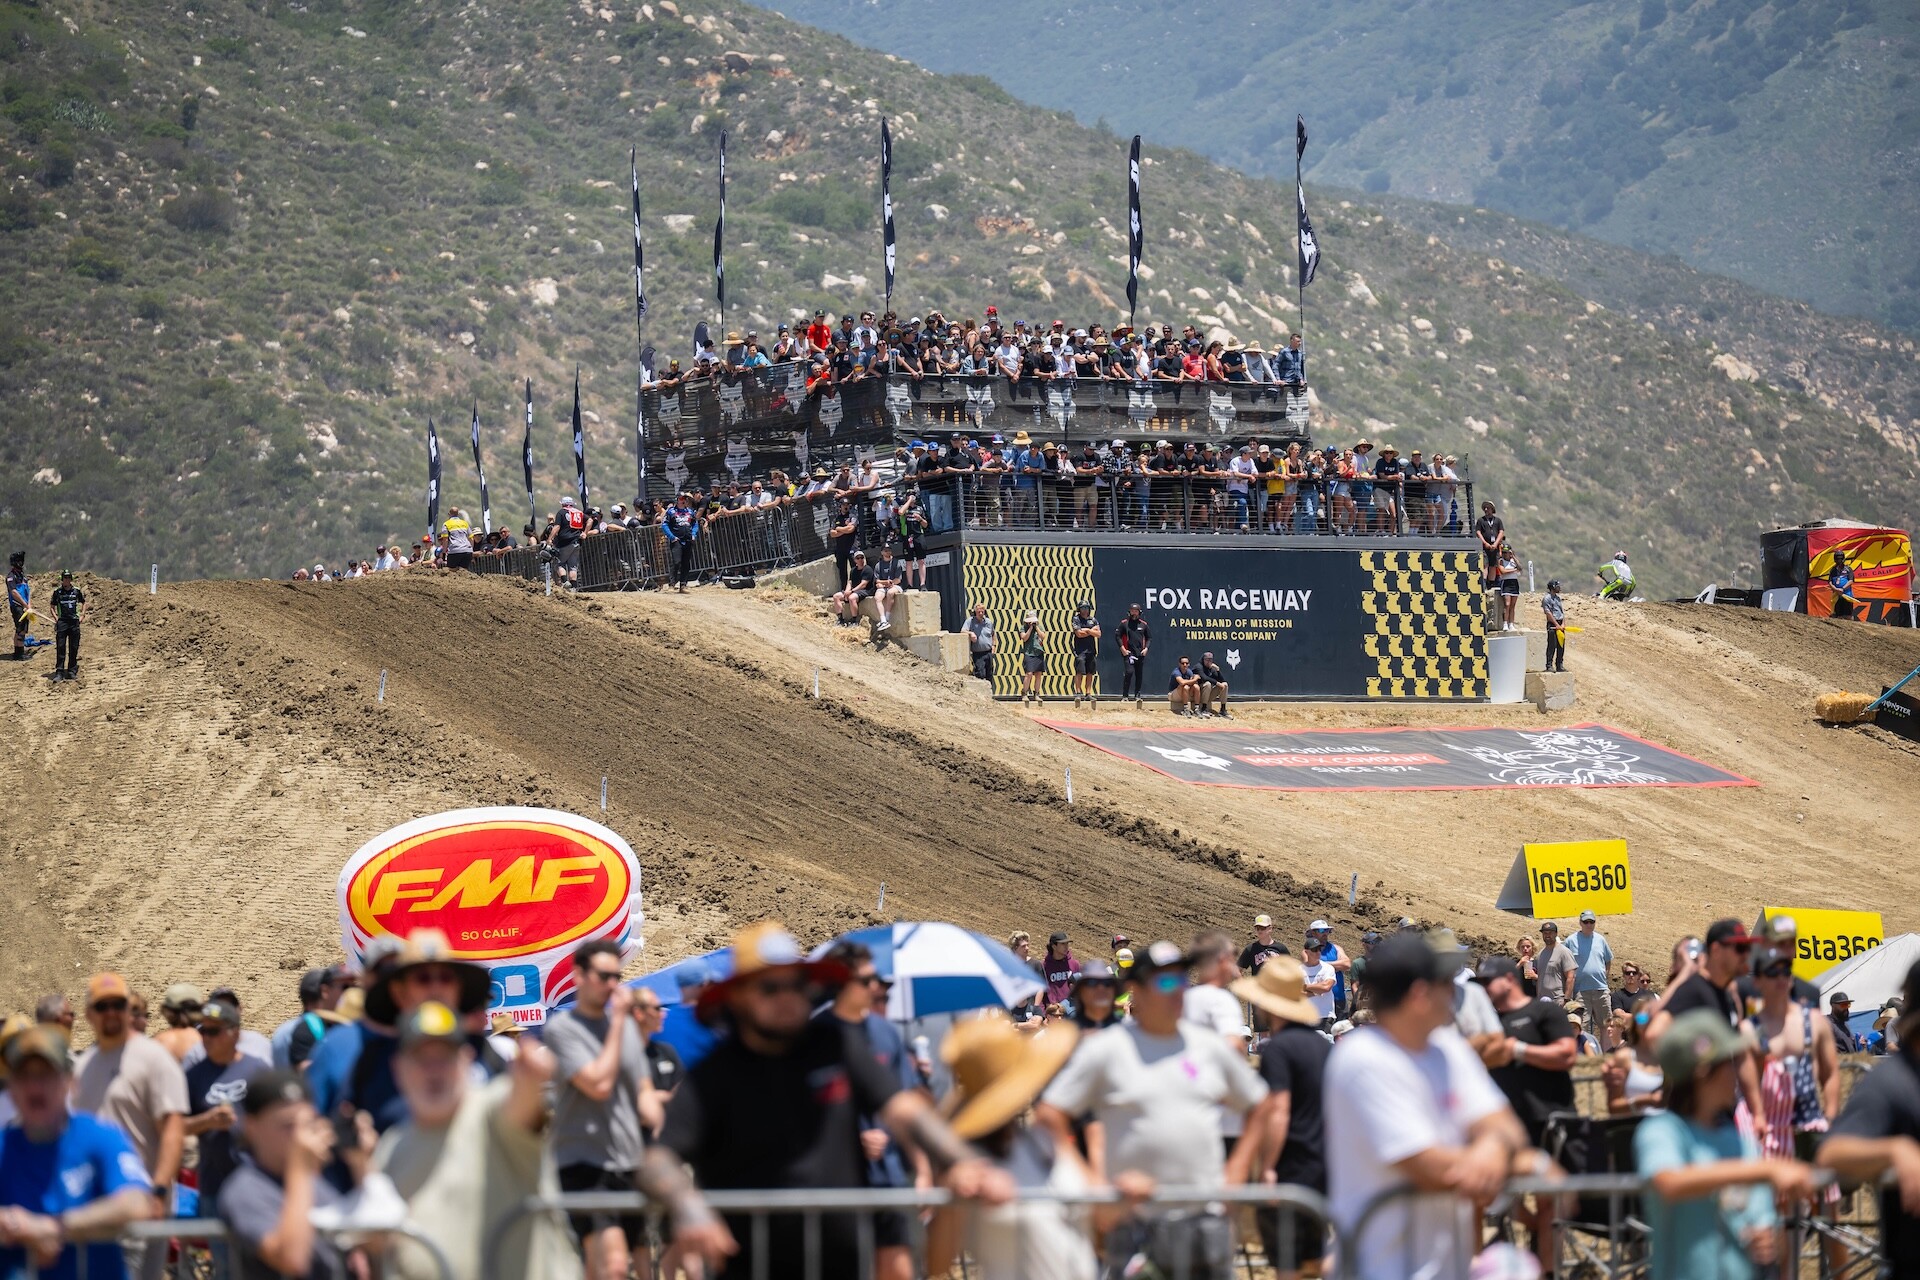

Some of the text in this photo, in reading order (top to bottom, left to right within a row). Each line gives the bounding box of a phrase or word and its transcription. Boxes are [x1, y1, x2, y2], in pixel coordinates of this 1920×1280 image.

[573, 513, 582, 523] 45
[1145, 588, 1312, 611] FOX RACEWAY
[1170, 618, 1293, 629] A PALA BAND OF MISSION
[1186, 631, 1277, 641] INDIANS COMPANY
[1242, 745, 1391, 754] THE ORIGINAL
[1332, 755, 1430, 764] COMPANY
[1310, 766, 1376, 774] SINCE
[1532, 864, 1627, 893] Insta360
[370, 855, 601, 916] FMF
[461, 927, 523, 941] SO CALIF.
[506, 1008, 542, 1023] OWER
